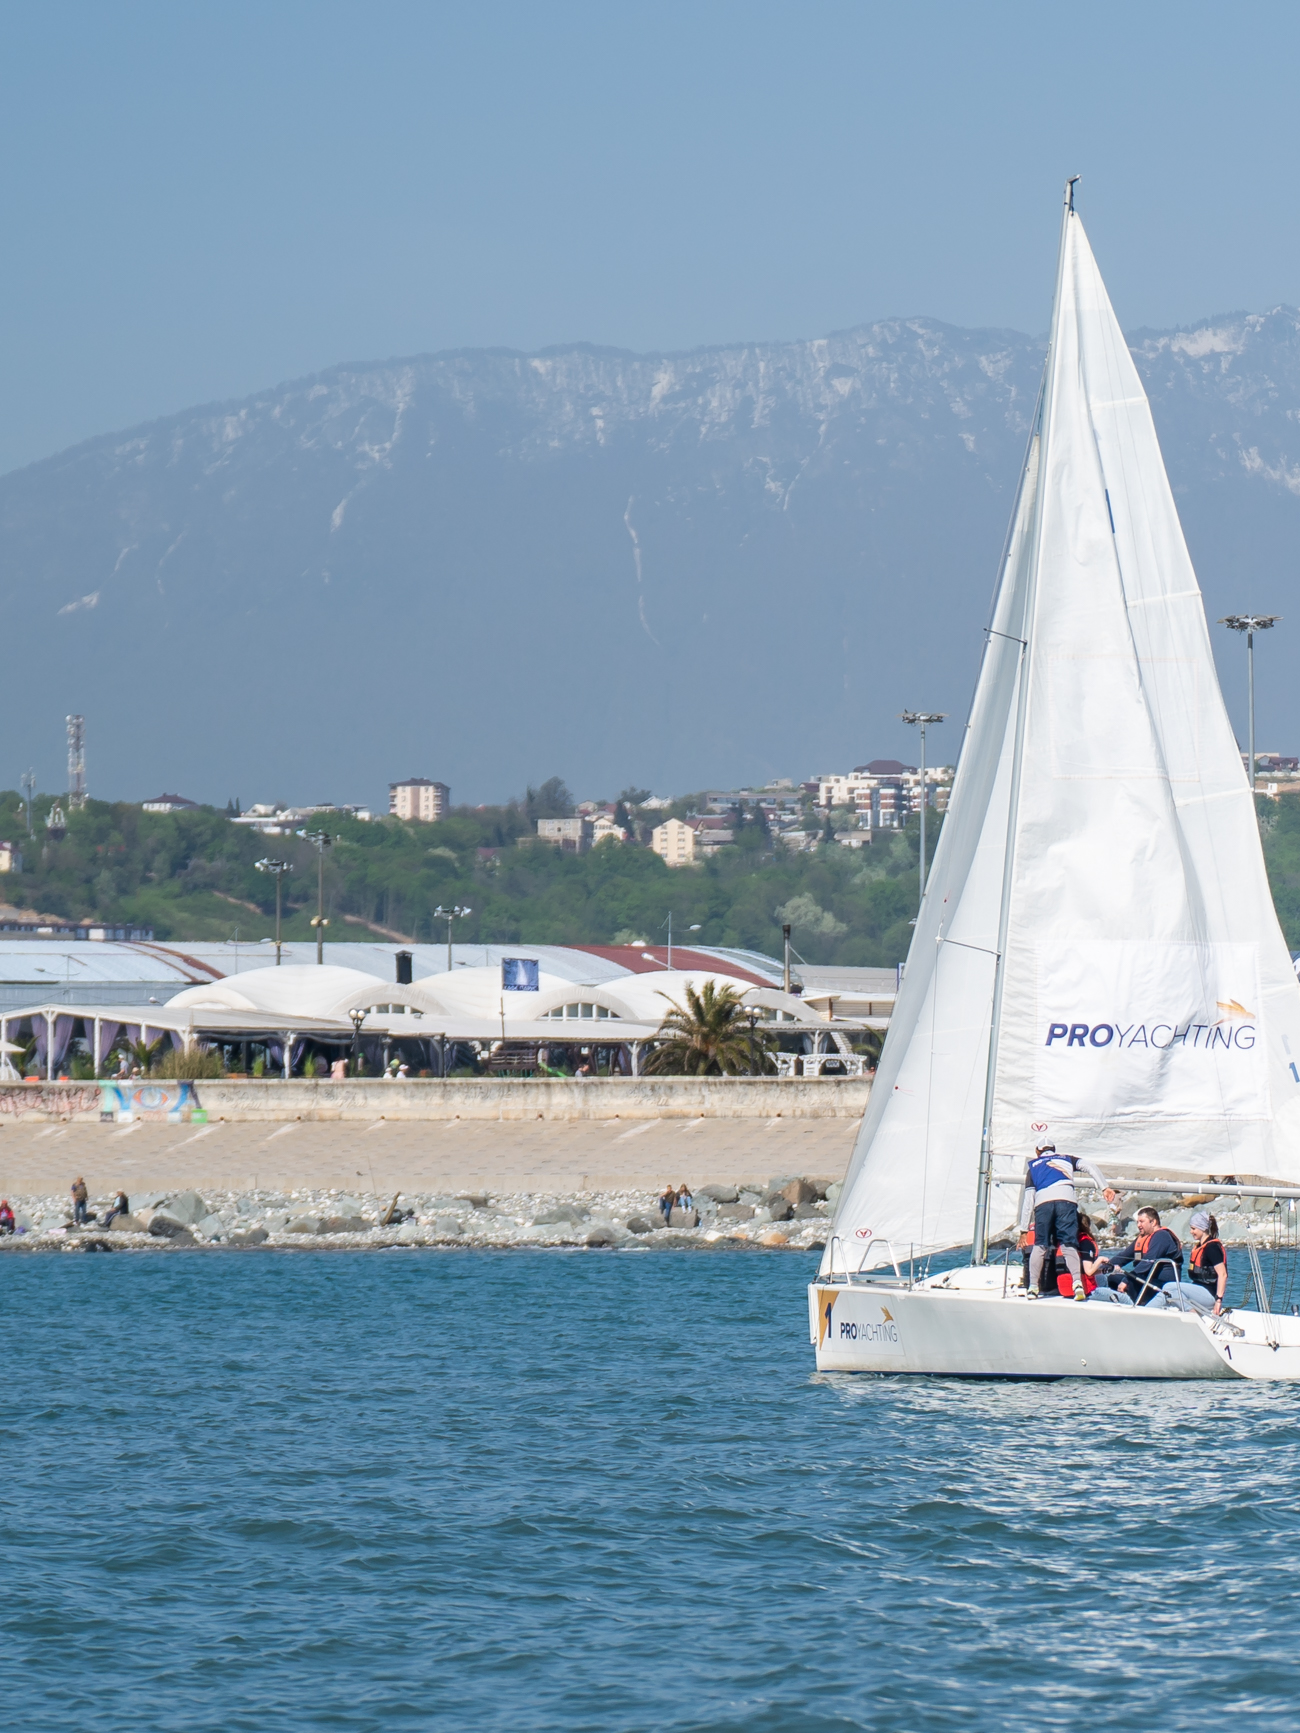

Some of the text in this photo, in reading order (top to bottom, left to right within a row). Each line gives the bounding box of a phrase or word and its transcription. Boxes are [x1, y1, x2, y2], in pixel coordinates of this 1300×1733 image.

[1045, 1023, 1255, 1049] PROYACHTING
[1289, 1062, 1300, 1083] 1
[825, 1302, 832, 1338] 1
[841, 1322, 897, 1342] PROYACHTING
[1224, 1344, 1232, 1360] 1
